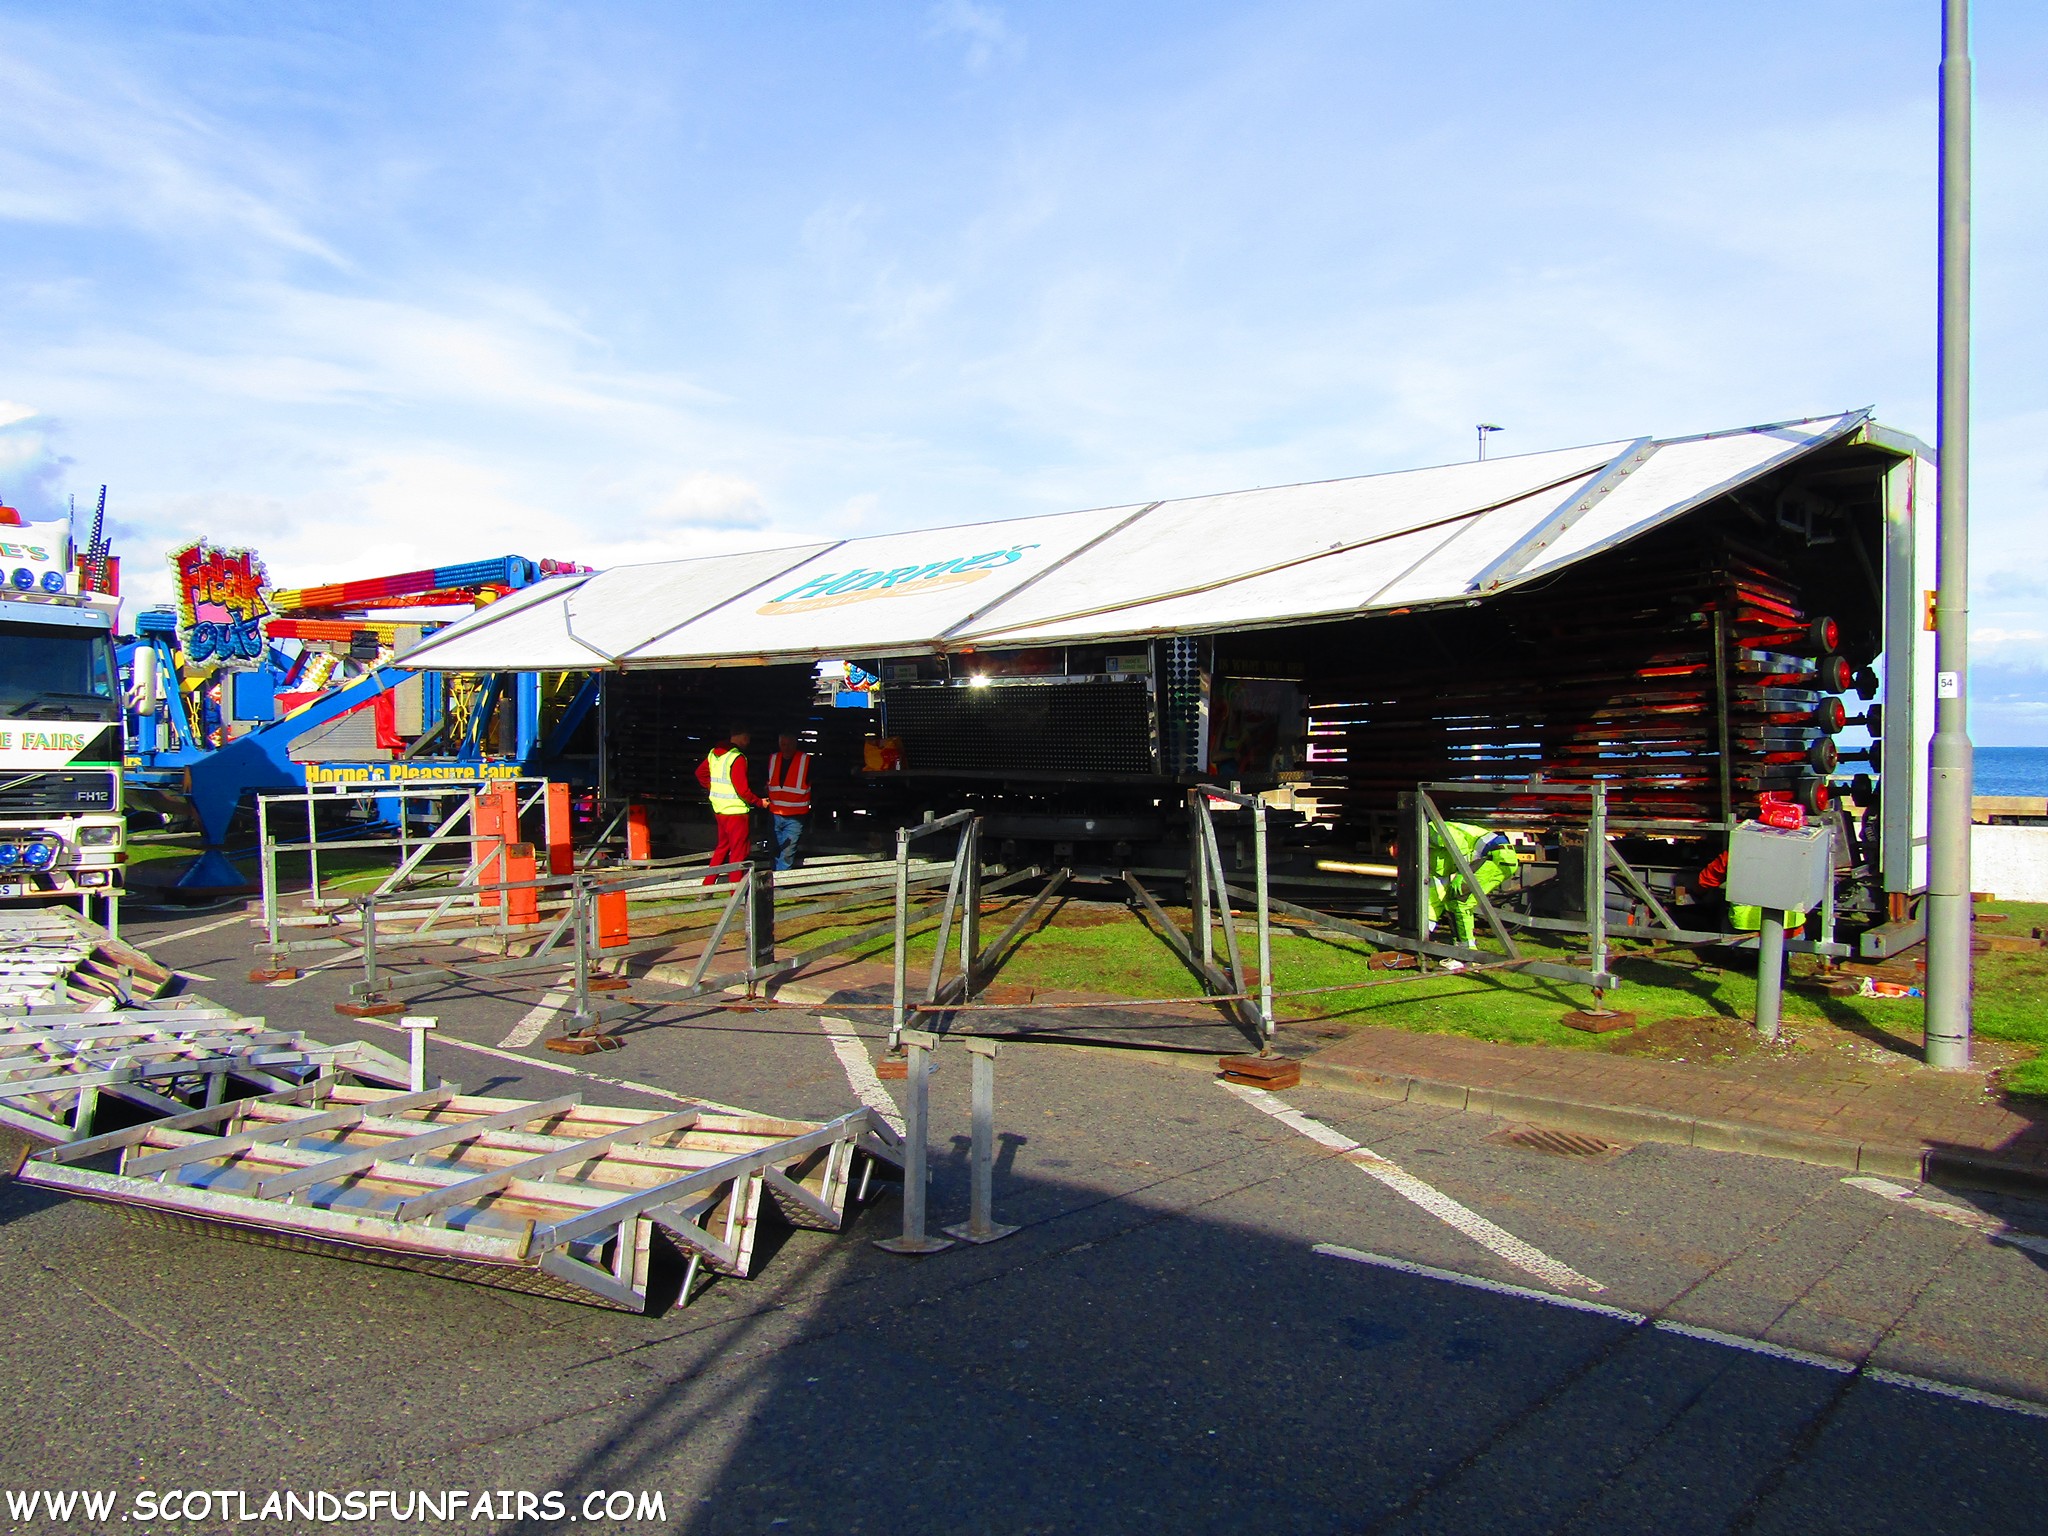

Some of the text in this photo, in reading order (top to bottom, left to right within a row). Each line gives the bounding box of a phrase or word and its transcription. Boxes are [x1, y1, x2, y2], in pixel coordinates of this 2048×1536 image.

[1940, 678, 1953, 688] 54
[21, 732, 86, 751] FAIRS
[305, 763, 523, 783] Horne's Pleasure Fairs
[77, 791, 109, 802] FH12
